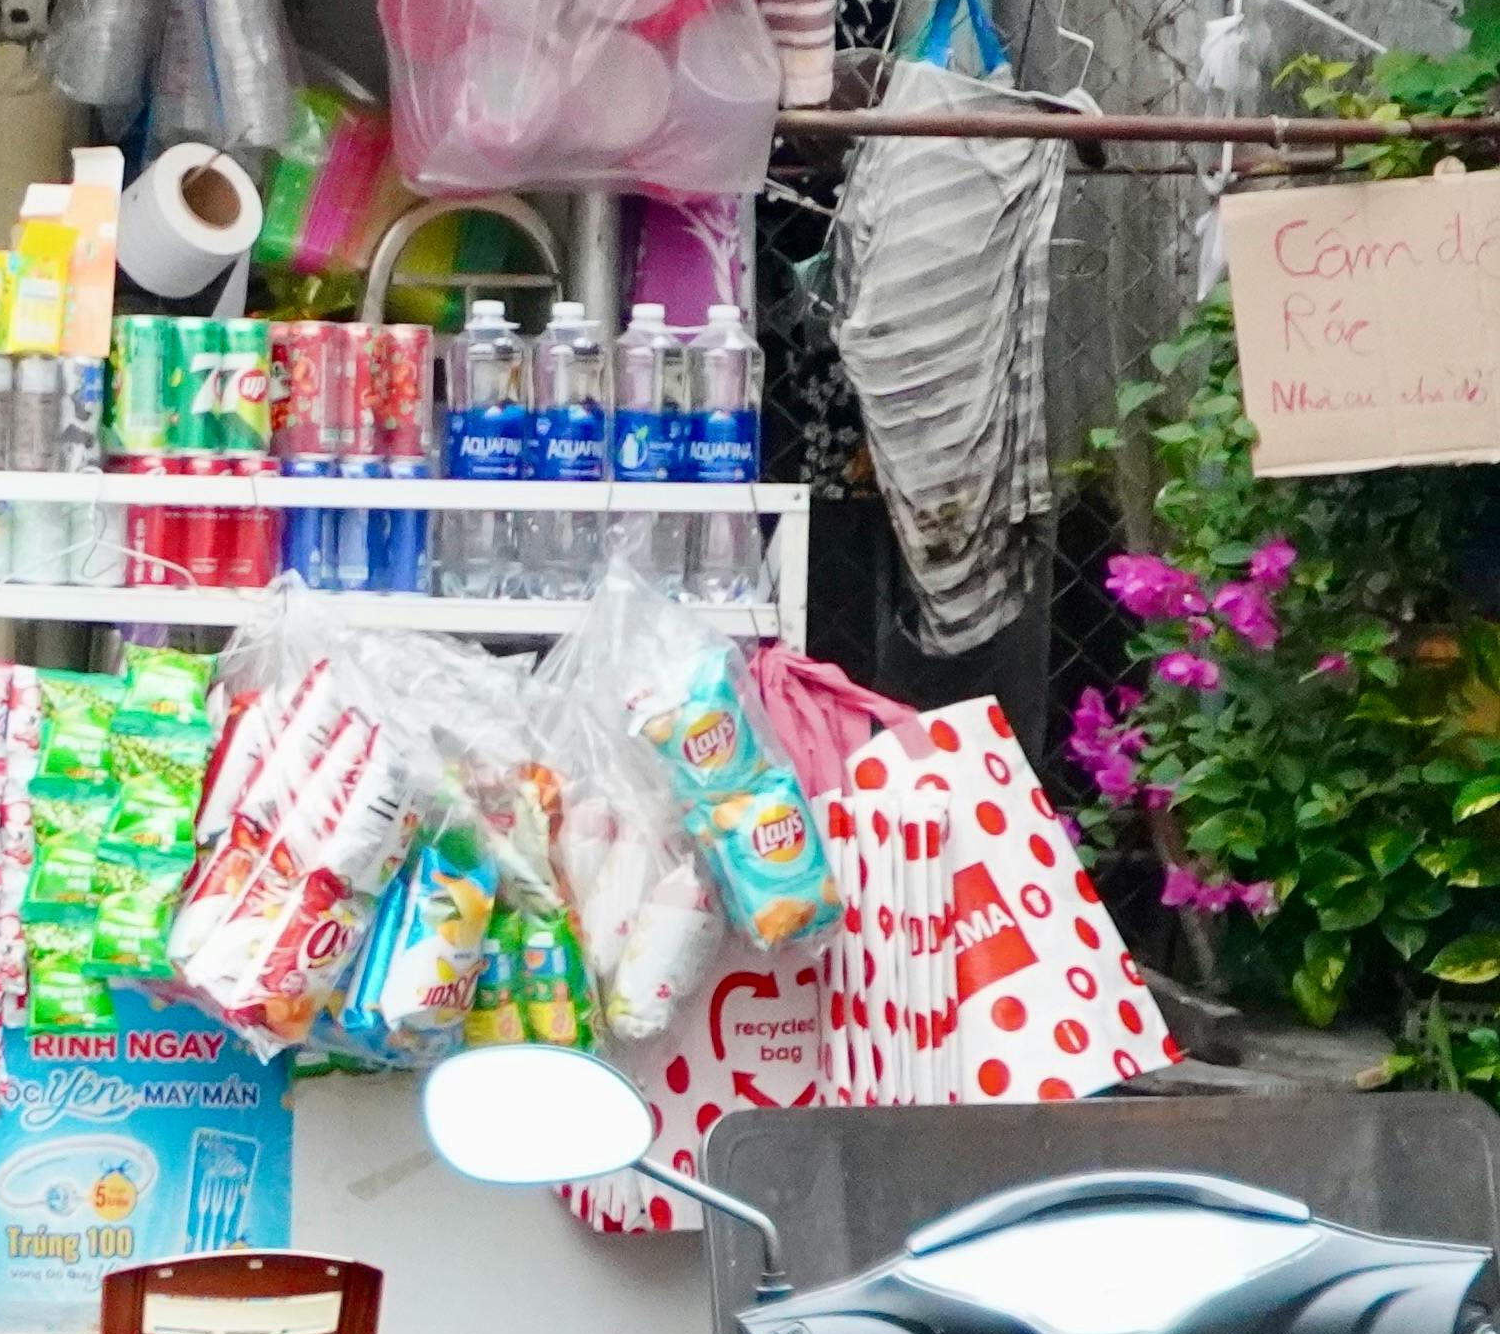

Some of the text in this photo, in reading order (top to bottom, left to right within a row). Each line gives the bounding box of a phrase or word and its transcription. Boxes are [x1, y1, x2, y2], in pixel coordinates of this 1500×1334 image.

[460, 435, 523, 457] AQUAFIN
[127, 1033, 226, 1060] NGAY
[759, 1044, 804, 1063] bag
[143, 1083, 196, 1106] MAY
[6, 1224, 135, 1265] Trúng 100
